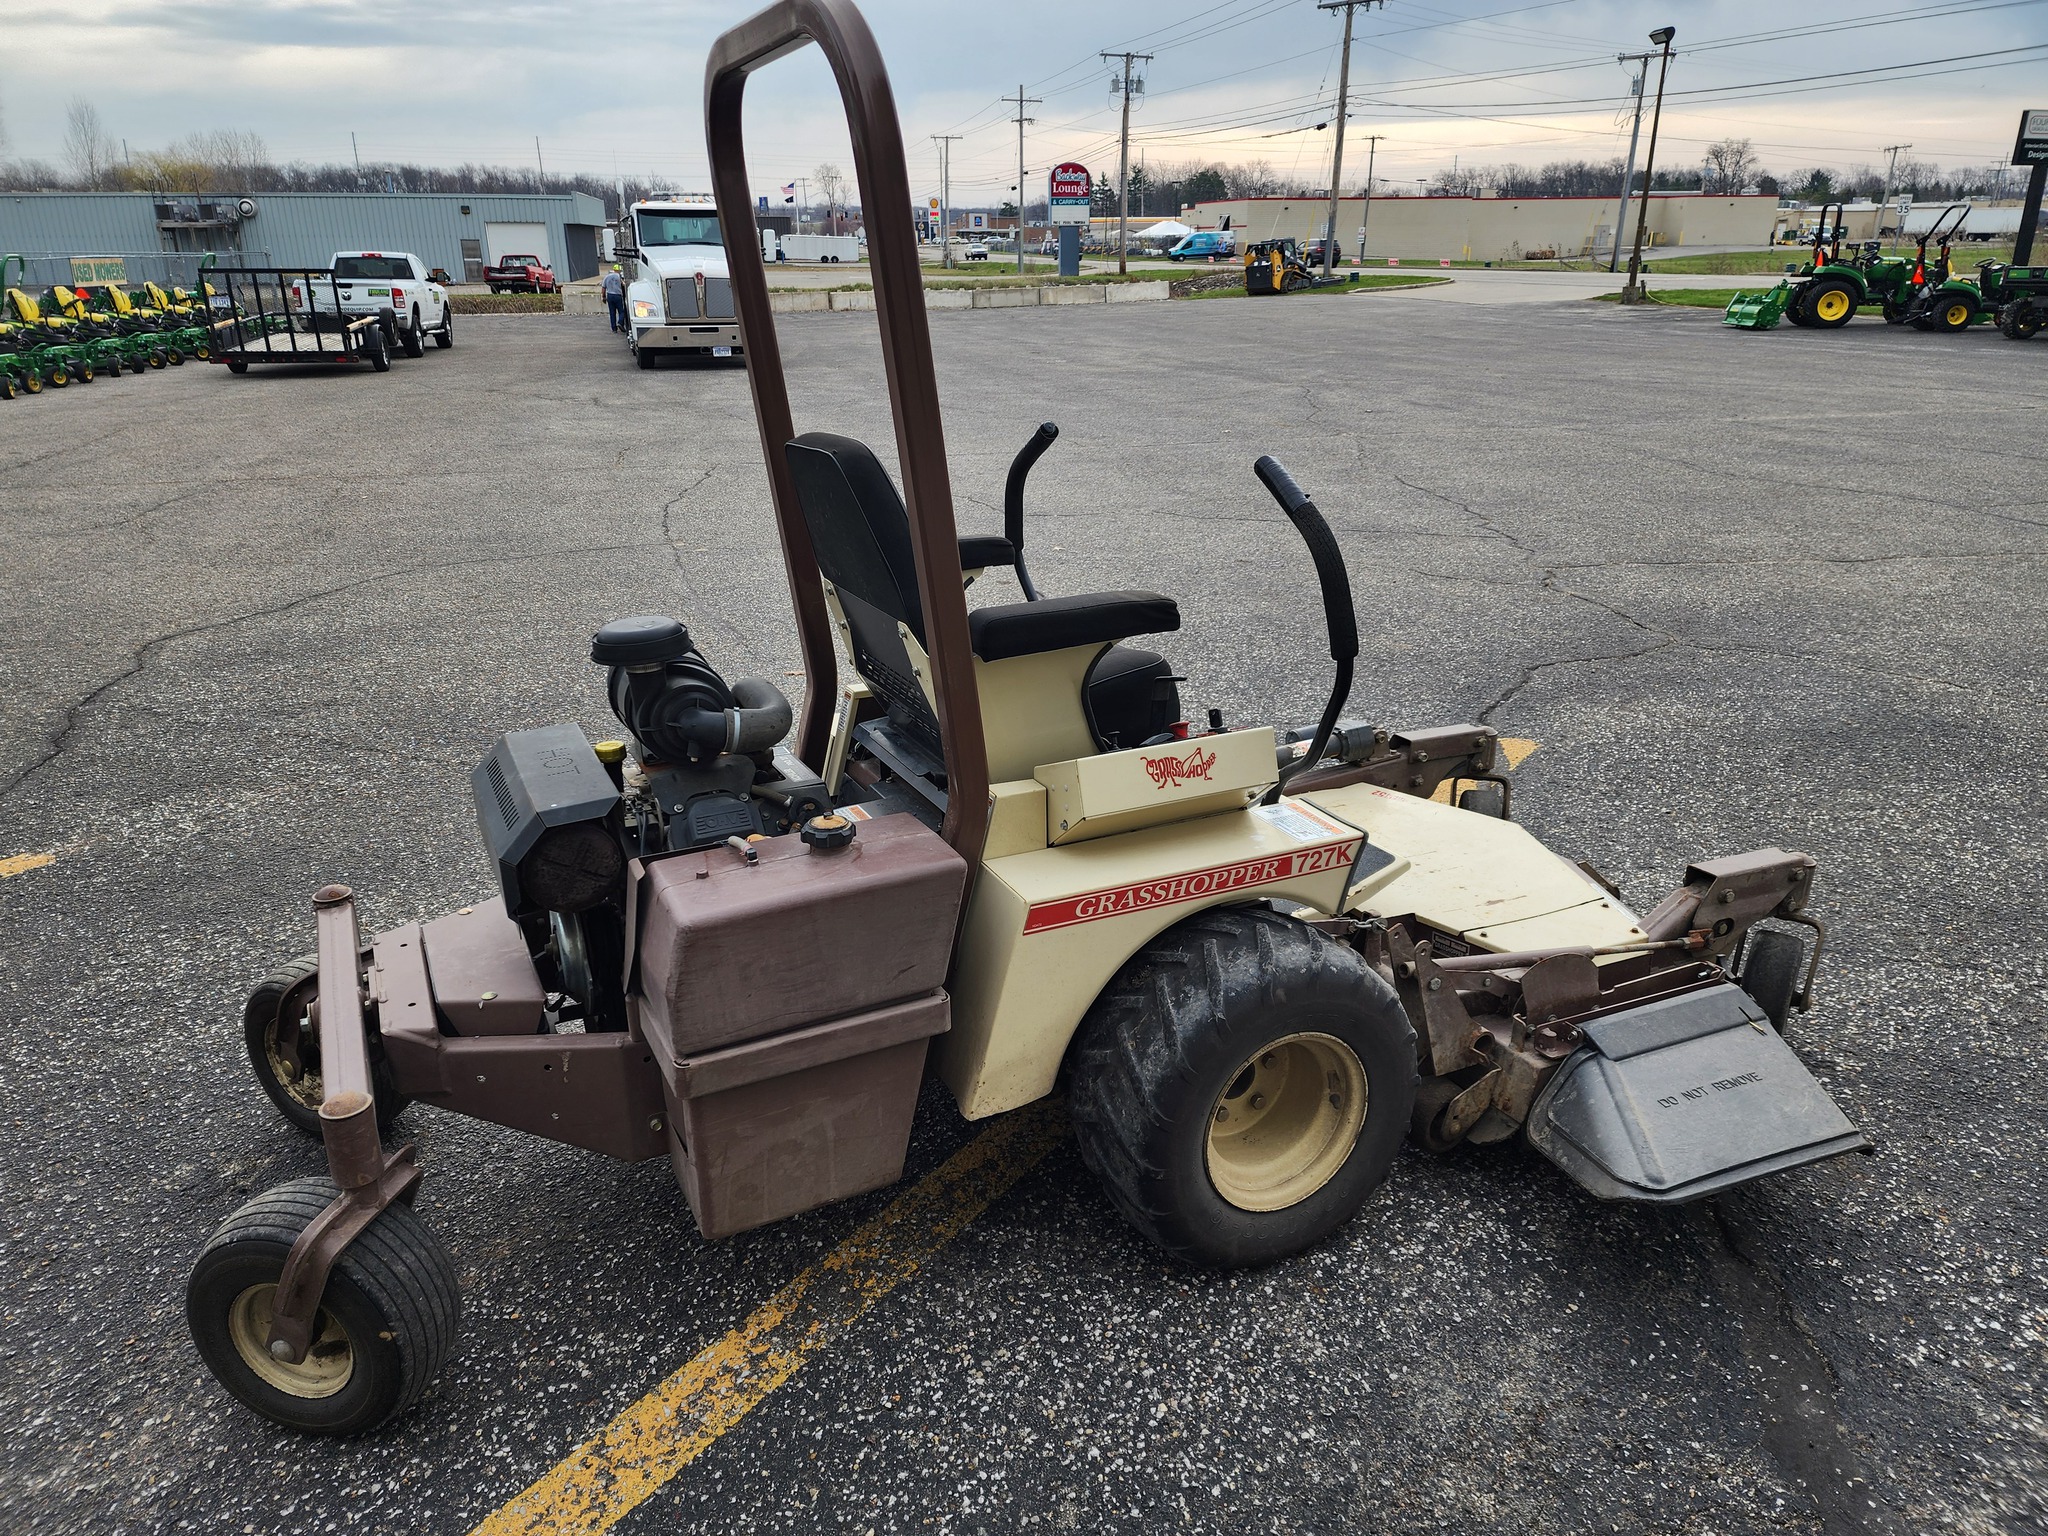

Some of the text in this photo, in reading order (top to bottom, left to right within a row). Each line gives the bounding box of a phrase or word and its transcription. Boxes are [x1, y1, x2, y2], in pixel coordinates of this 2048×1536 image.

[1053, 182, 1089, 196] Lounge
[1897, 205, 1910, 213] 35
[72, 262, 126, 282] USED MOWERS
[1075, 843, 1353, 918] GRASSHOPPER 727K
[1657, 1072, 1763, 1108] DO NOT REMOVE
